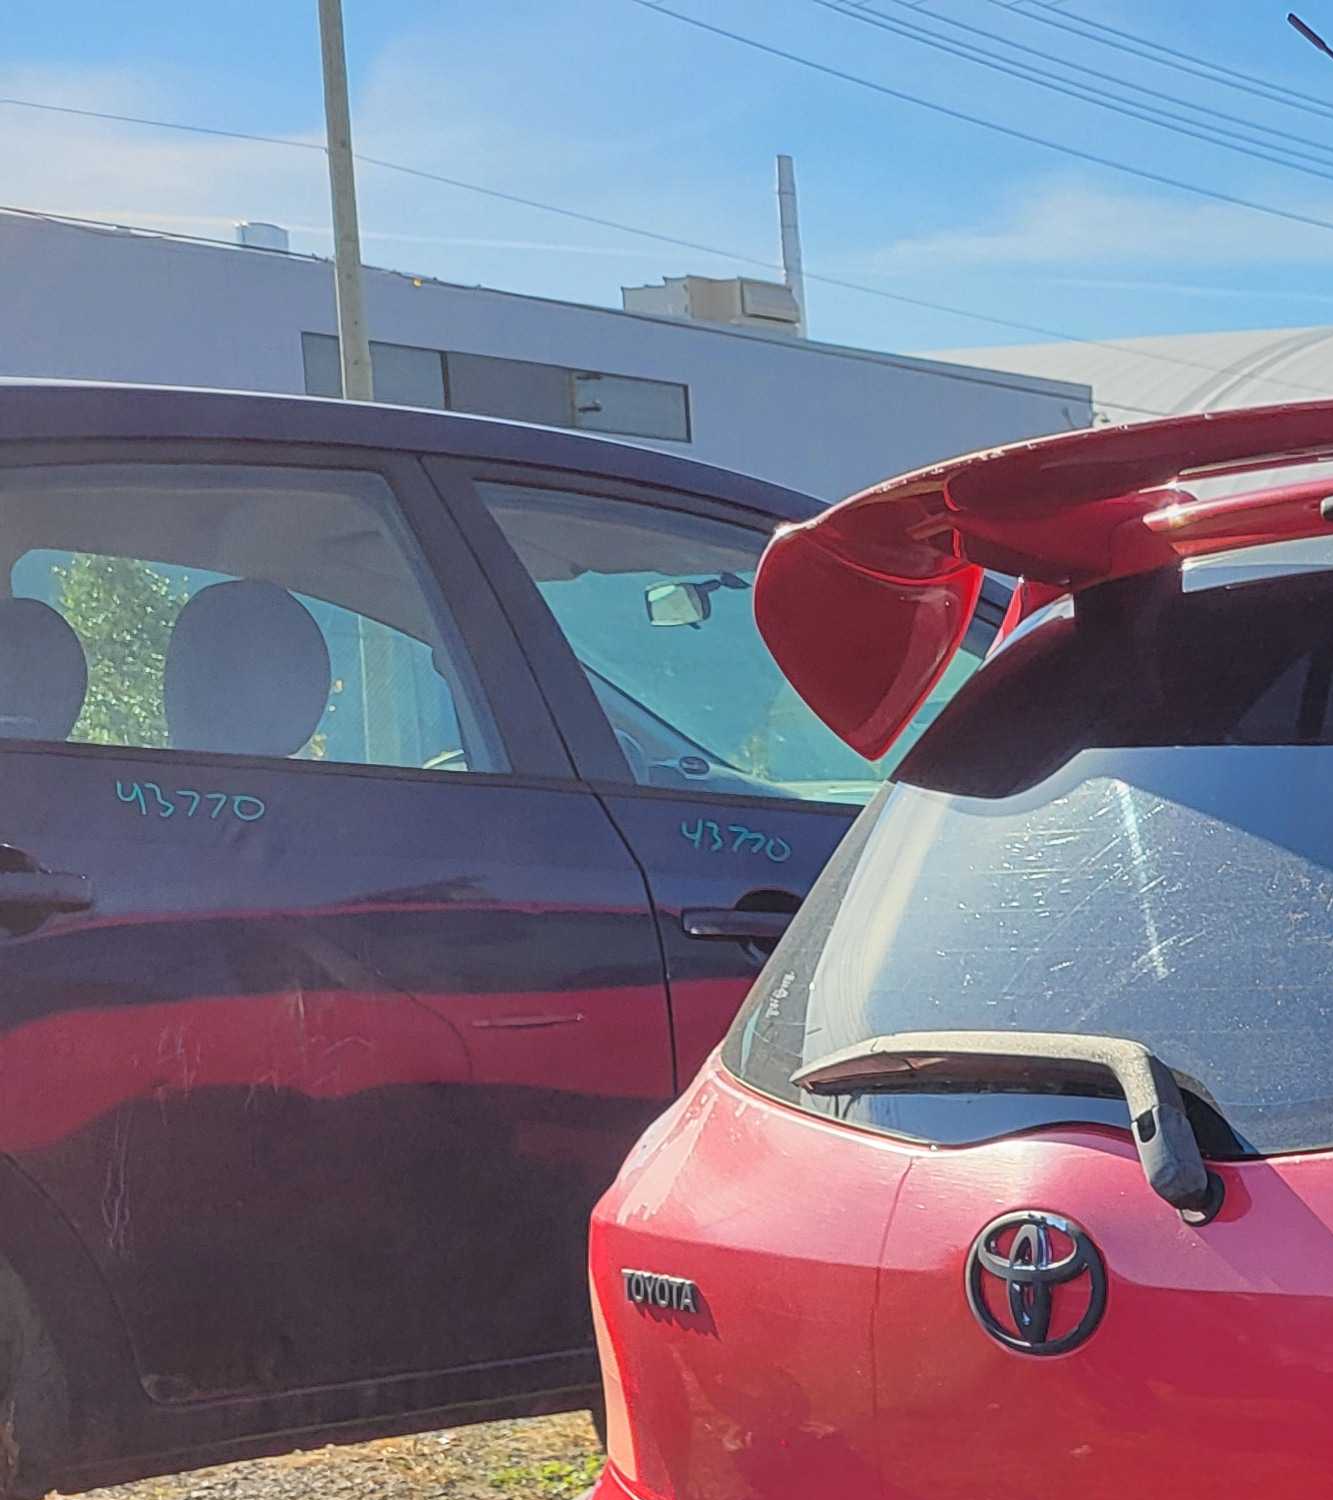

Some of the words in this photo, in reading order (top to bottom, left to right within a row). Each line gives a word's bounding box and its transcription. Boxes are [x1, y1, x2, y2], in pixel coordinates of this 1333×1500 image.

[115, 780, 265, 821] 43770
[681, 819, 792, 862] 43770
[621, 1268, 698, 1313] TOYOTA
